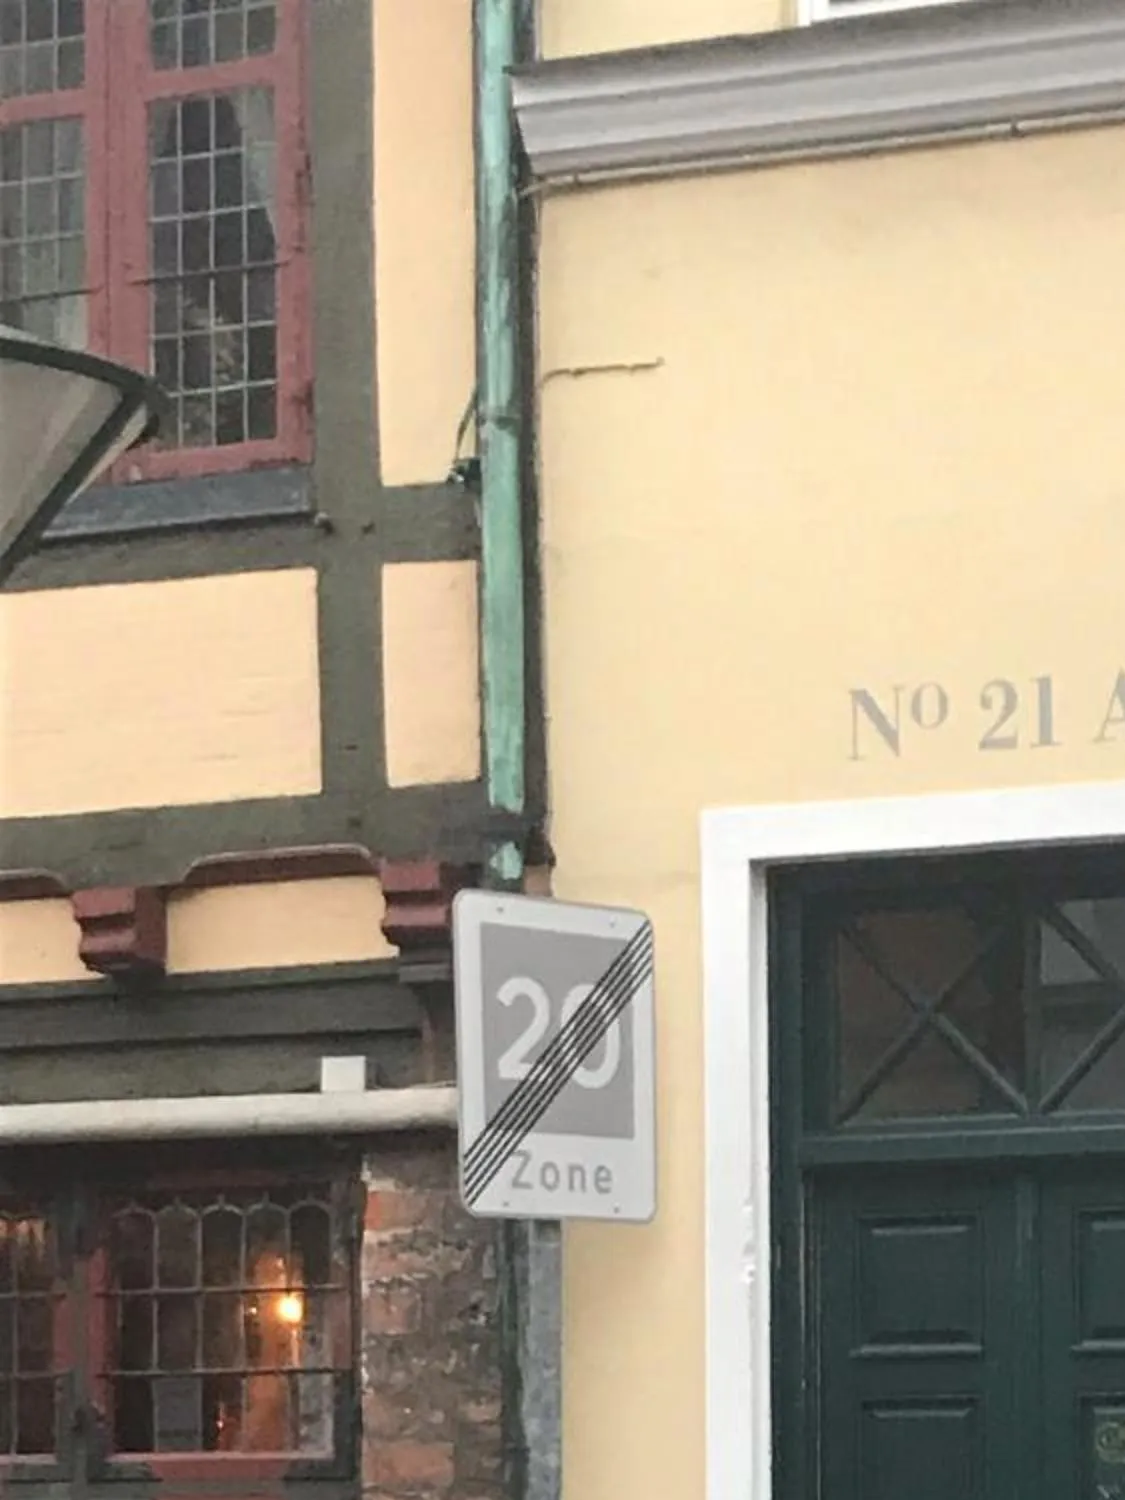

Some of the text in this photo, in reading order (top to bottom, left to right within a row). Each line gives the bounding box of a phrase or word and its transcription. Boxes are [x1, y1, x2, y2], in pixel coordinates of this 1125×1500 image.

[978, 675, 1062, 752] 21
[496, 976, 621, 1089] 20
[511, 1150, 614, 1195] Zone
